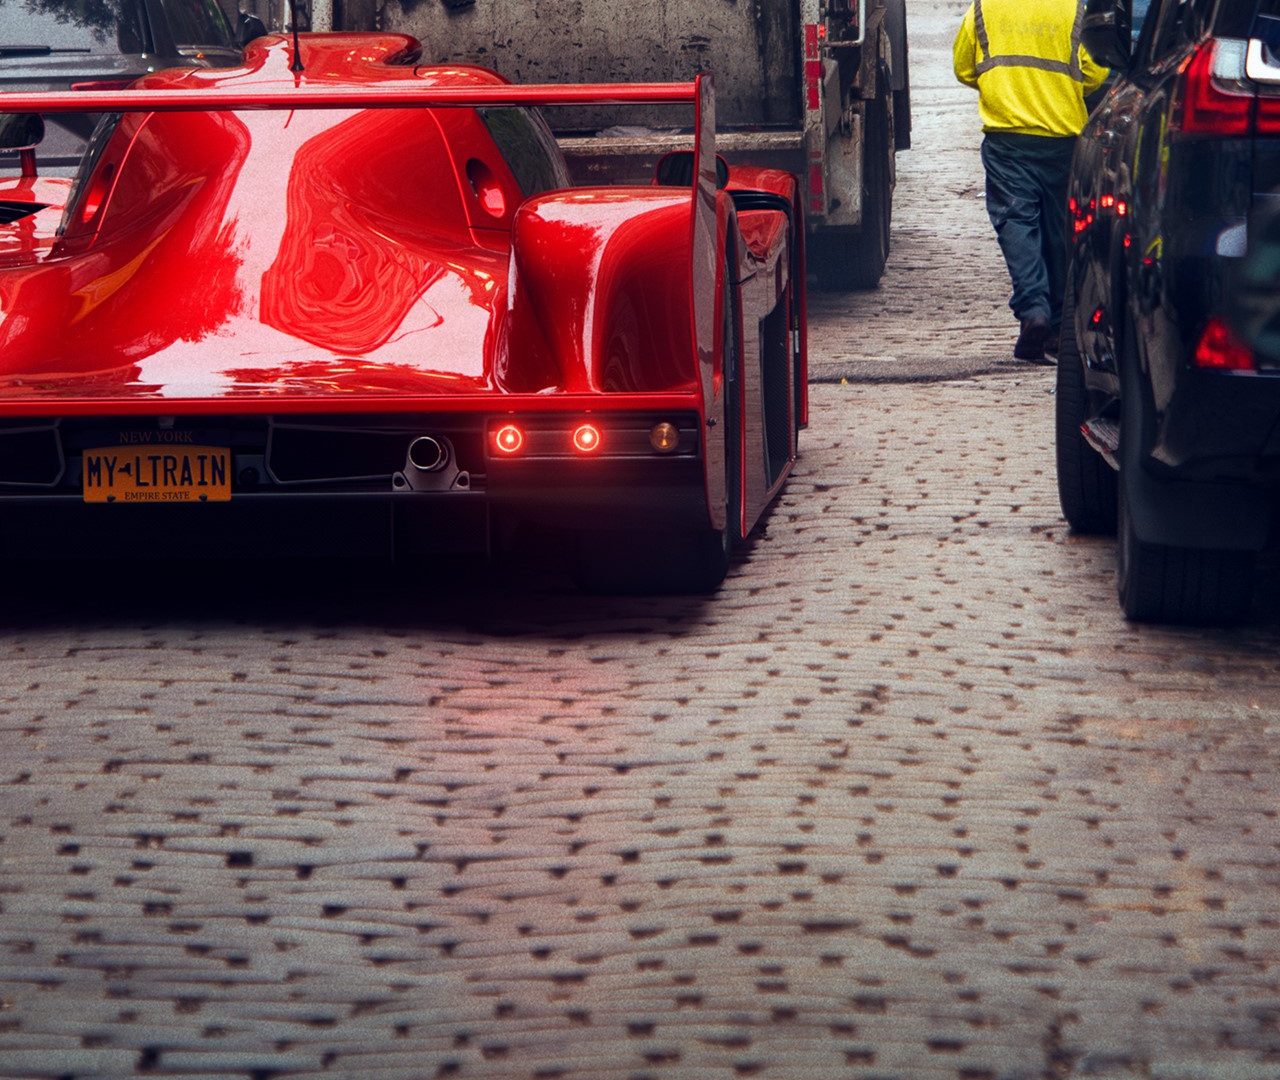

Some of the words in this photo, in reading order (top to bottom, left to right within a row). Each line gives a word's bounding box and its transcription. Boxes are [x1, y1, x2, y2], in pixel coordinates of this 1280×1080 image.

[119, 431, 152, 444] NEW
[156, 431, 193, 443] YORK
[87, 455, 118, 487] MY
[135, 454, 226, 487] LTRAIN
[124, 491, 160, 501] EMPIRE
[162, 491, 190, 500] STATE
